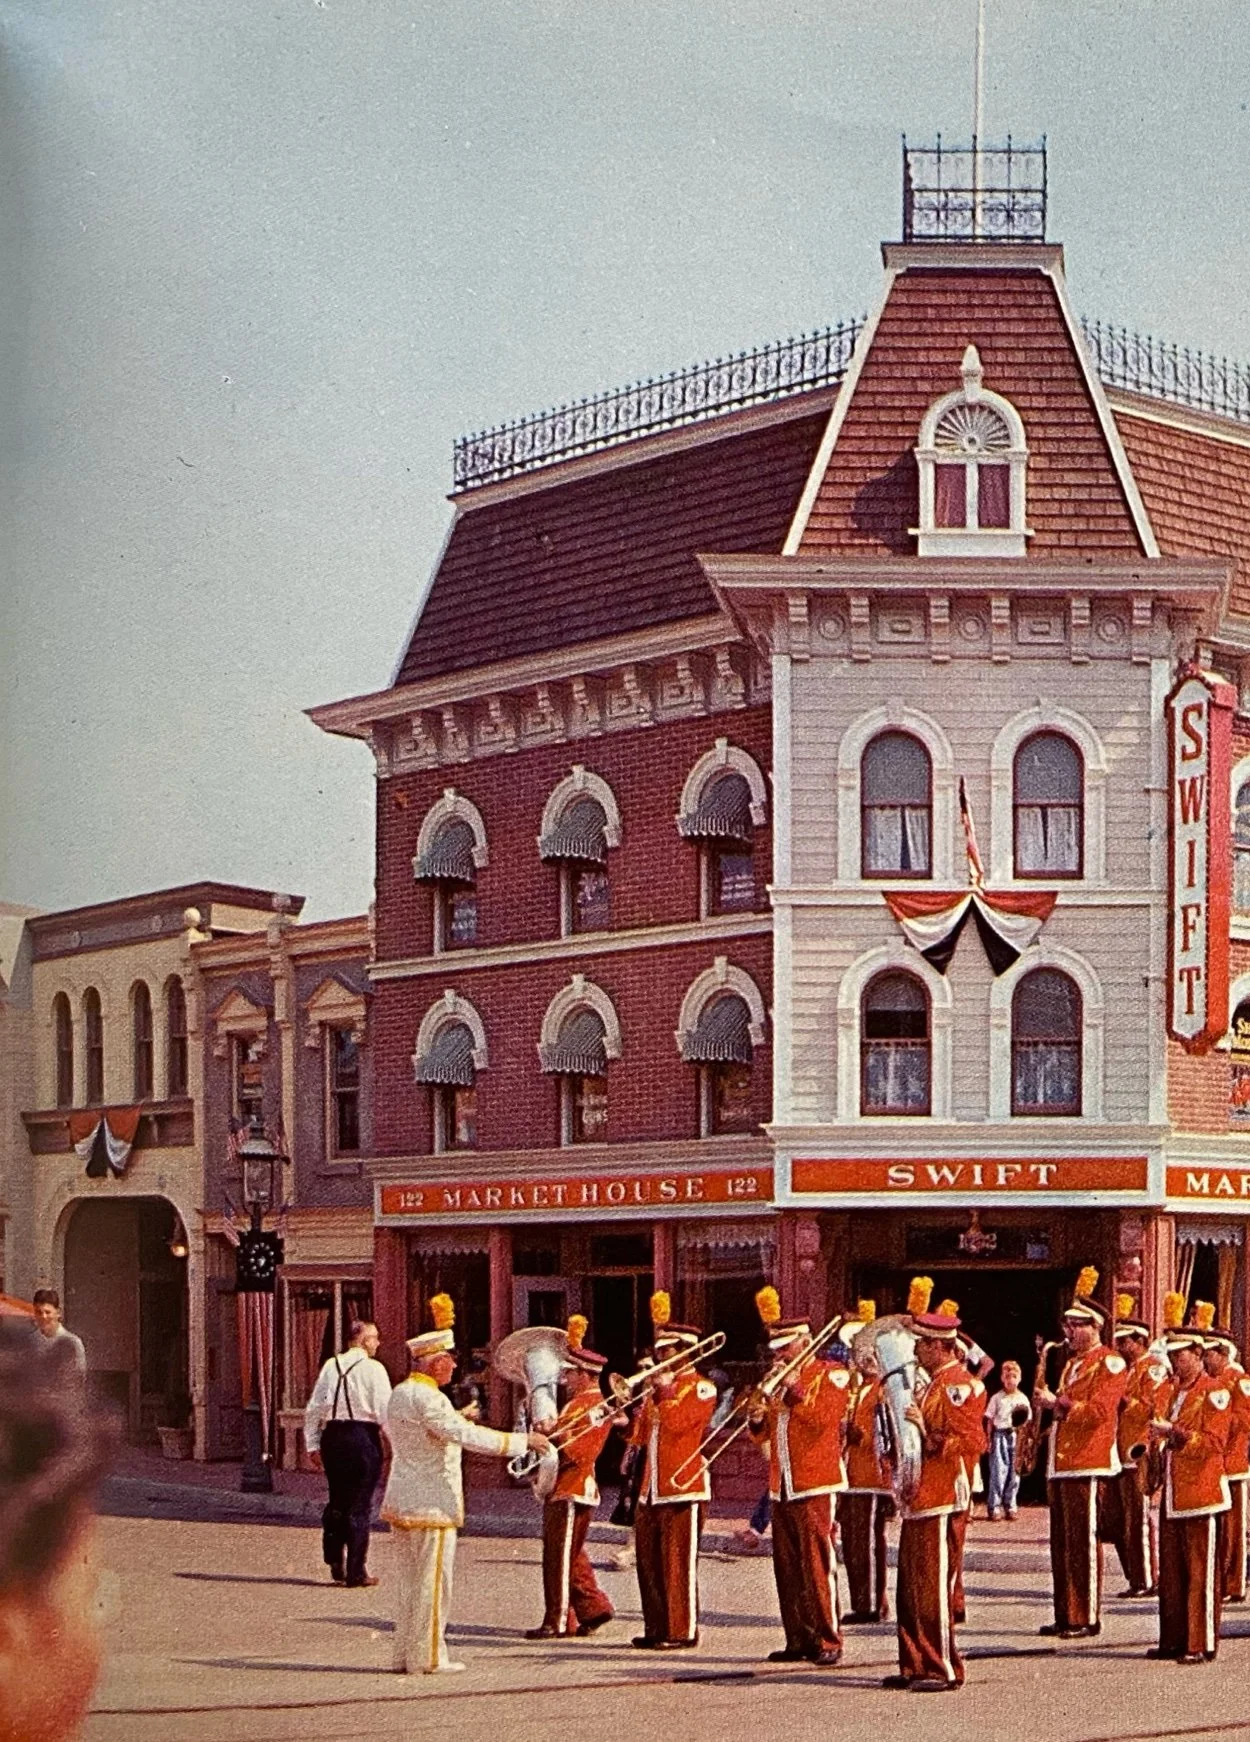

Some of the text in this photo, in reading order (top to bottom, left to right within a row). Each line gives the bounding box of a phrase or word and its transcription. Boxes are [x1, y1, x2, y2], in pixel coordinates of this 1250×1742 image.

[1176, 701, 1205, 1016] SWIFT
[887, 1162, 1058, 1187] SWIFT
[399, 1177, 758, 1209] 122 MARKET HOUSE 122
